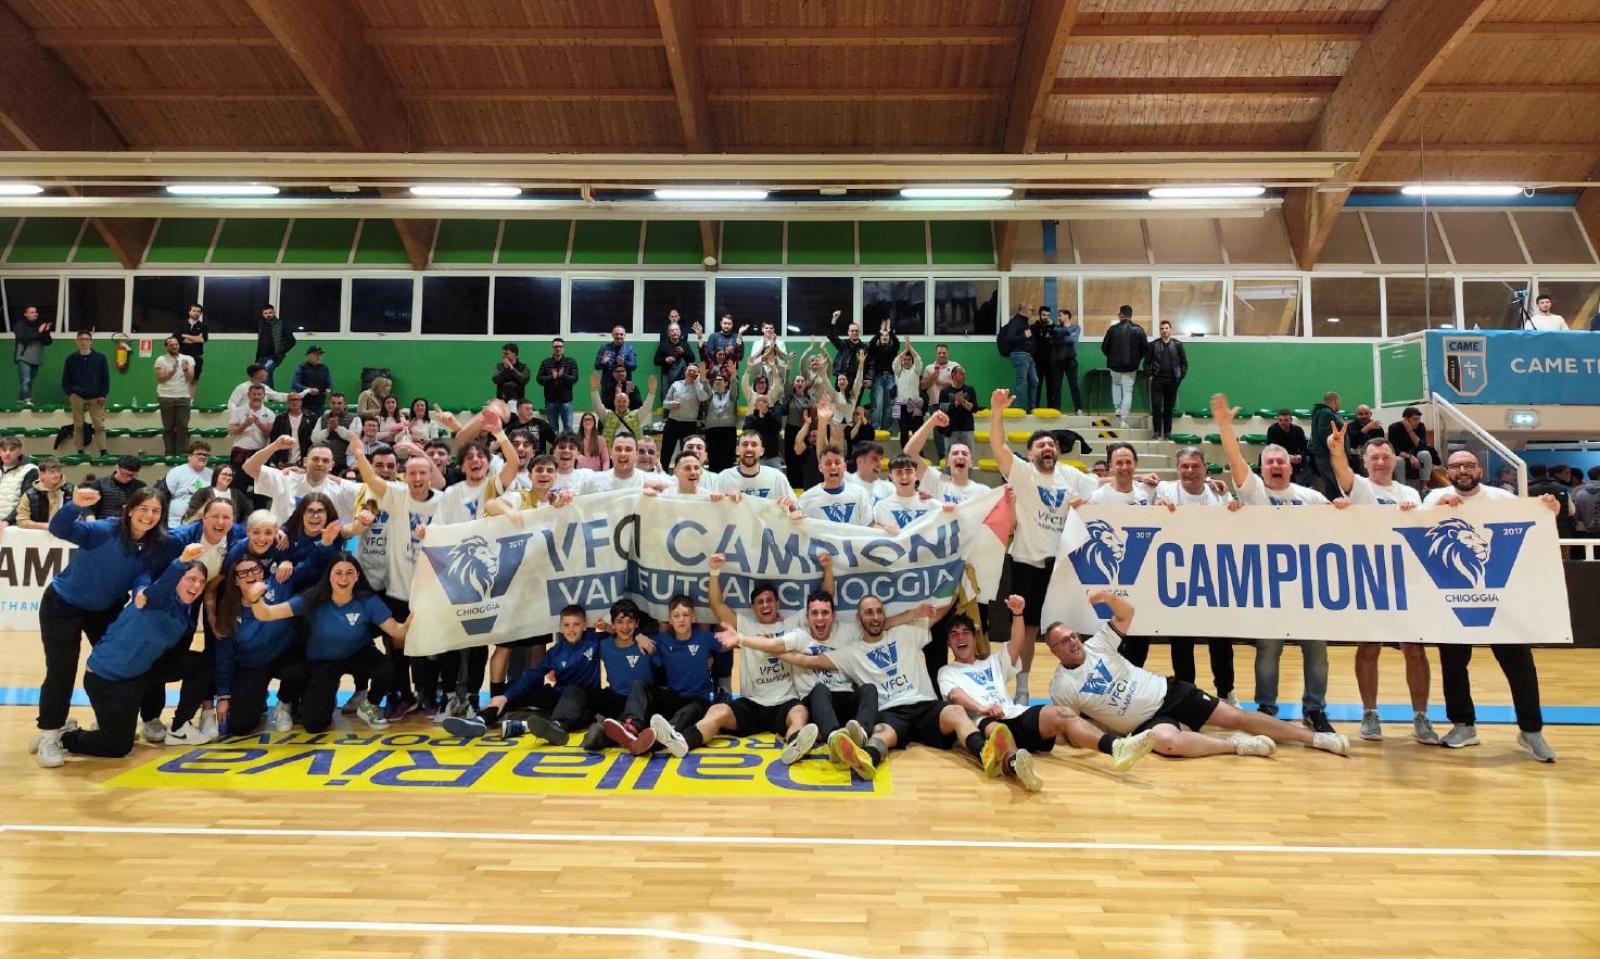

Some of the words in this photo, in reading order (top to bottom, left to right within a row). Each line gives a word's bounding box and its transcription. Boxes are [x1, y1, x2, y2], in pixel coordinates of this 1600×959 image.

[1449, 341, 1479, 351] CAME
[1510, 357, 1578, 374] CAME
[1582, 358, 1600, 374] T
[1503, 528, 1523, 536] 2017
[508, 540, 524, 549] 2017
[666, 519, 960, 575] CAMPIONI
[0, 547, 79, 587] AM
[1156, 542, 1408, 612] CAMPIONI
[1445, 594, 1499, 603] CHIOGGIA
[456, 603, 500, 617] CHIOGGIA
